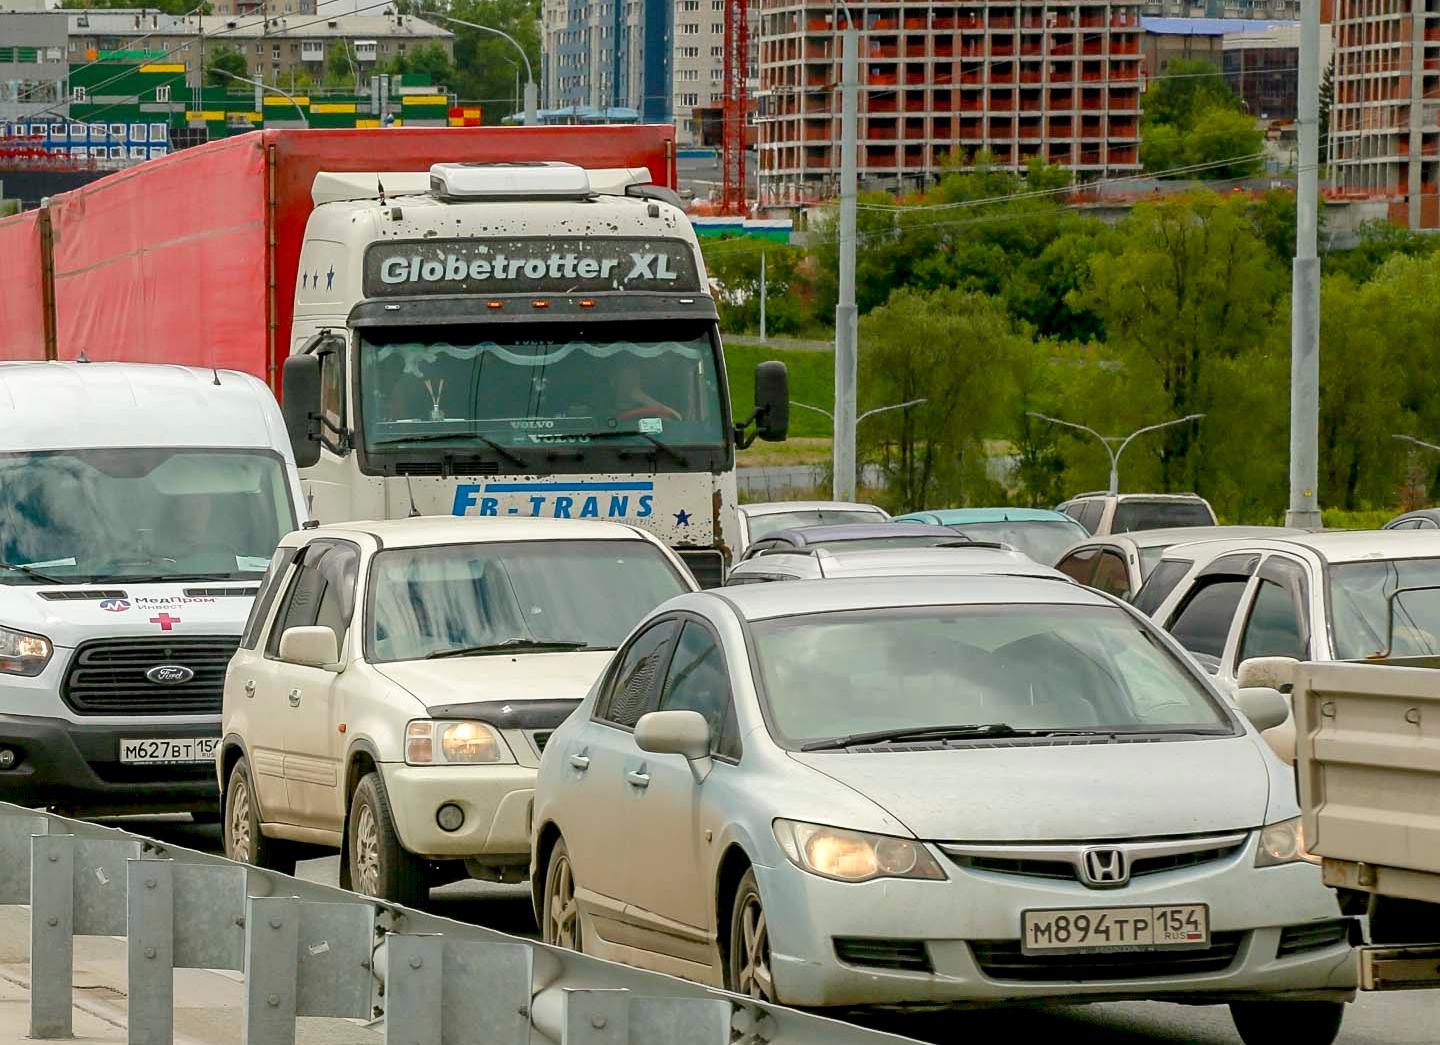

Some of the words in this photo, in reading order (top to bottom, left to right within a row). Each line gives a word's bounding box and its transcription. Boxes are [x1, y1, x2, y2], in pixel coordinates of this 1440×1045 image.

[380, 253, 618, 284] Globetrotter
[627, 253, 677, 280] XL
[511, 420, 554, 429] VOLVO
[158, 668, 183, 680] Ford
[125, 741, 192, 759] М627ВТ
[1033, 914, 1149, 944] М894ТР
[1156, 909, 1199, 932] 154
[1165, 932, 1186, 941] RUS
